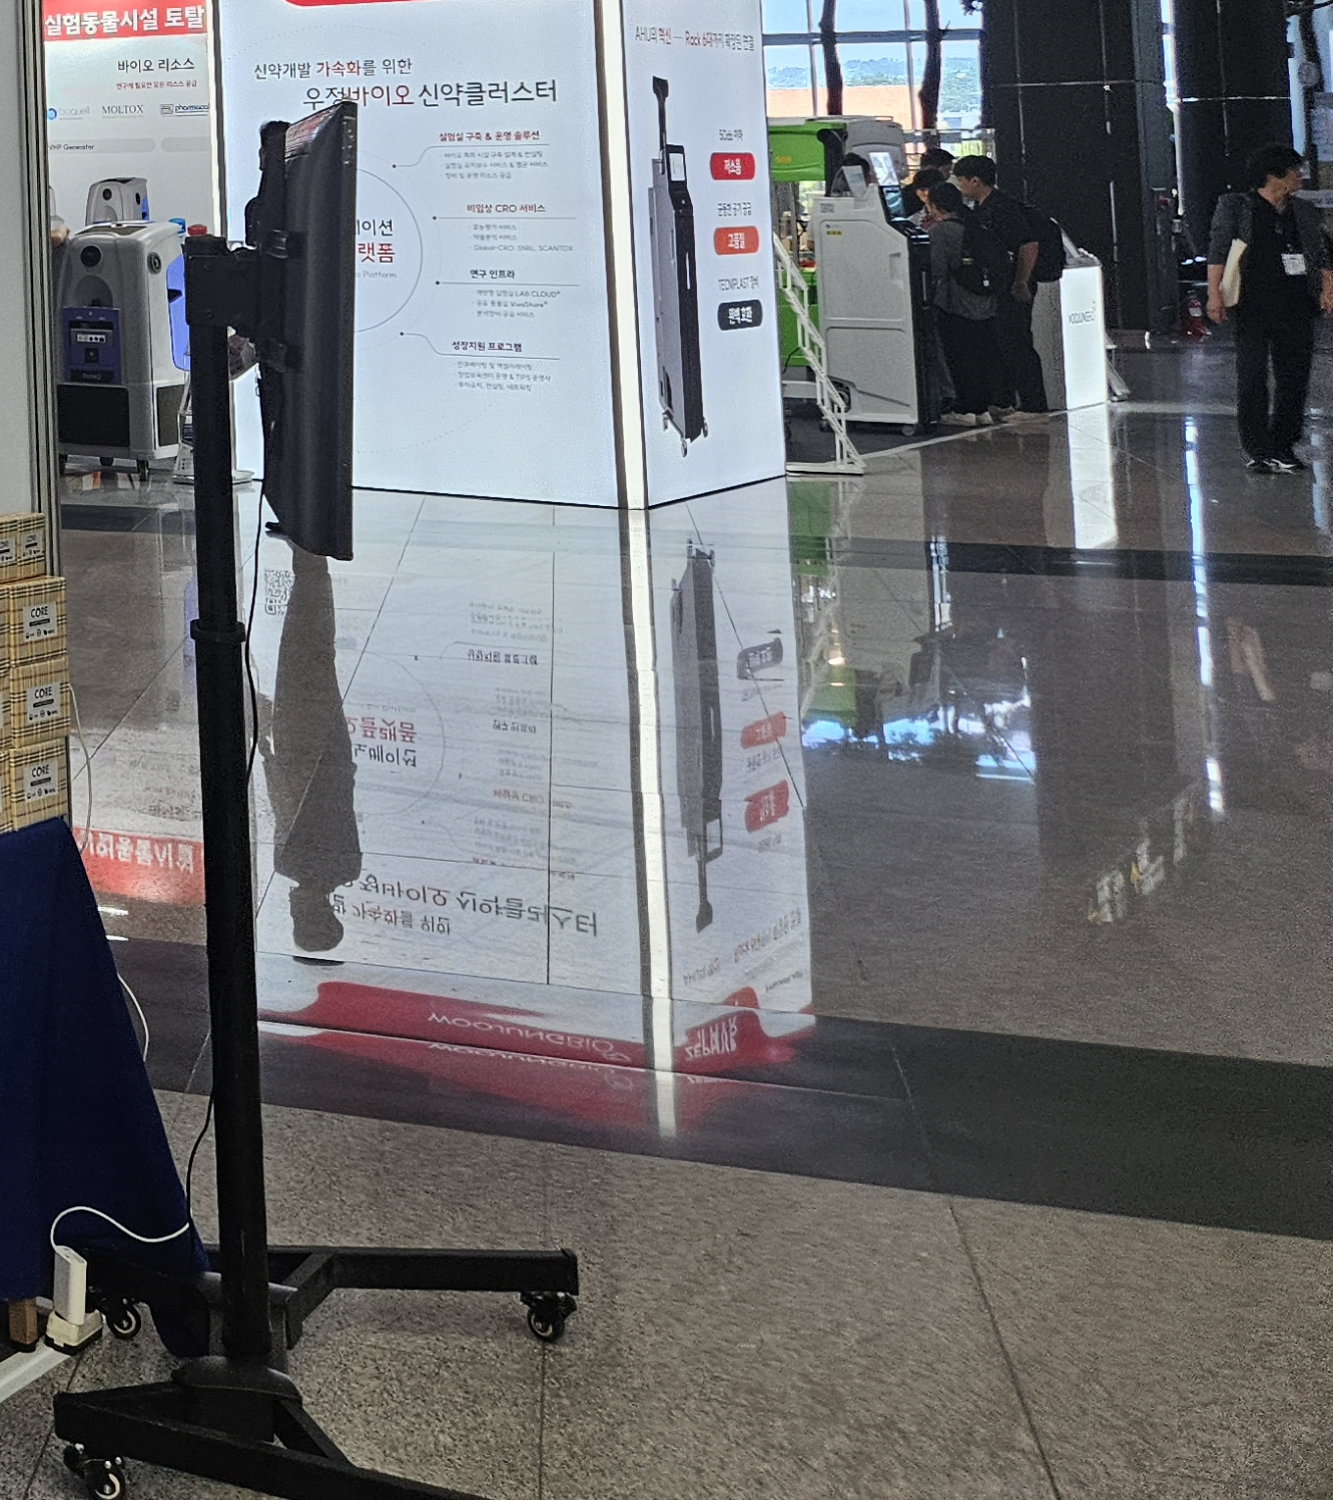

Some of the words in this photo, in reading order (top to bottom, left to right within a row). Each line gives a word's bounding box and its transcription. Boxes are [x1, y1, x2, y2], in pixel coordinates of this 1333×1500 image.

[45, 8, 158, 36] 실험동물시설
[164, 5, 204, 29] 토탈
[118, 60, 154, 72] 바이오
[158, 58, 194, 72] 리소스
[255, 62, 311, 79] 신약개발
[317, 60, 376, 77] 가속화를
[382, 58, 412, 74] 위한
[419, 80, 556, 106] 신약클러스터
[102, 105, 143, 113] MOLTOX
[520, 204, 545, 212] 서비스
